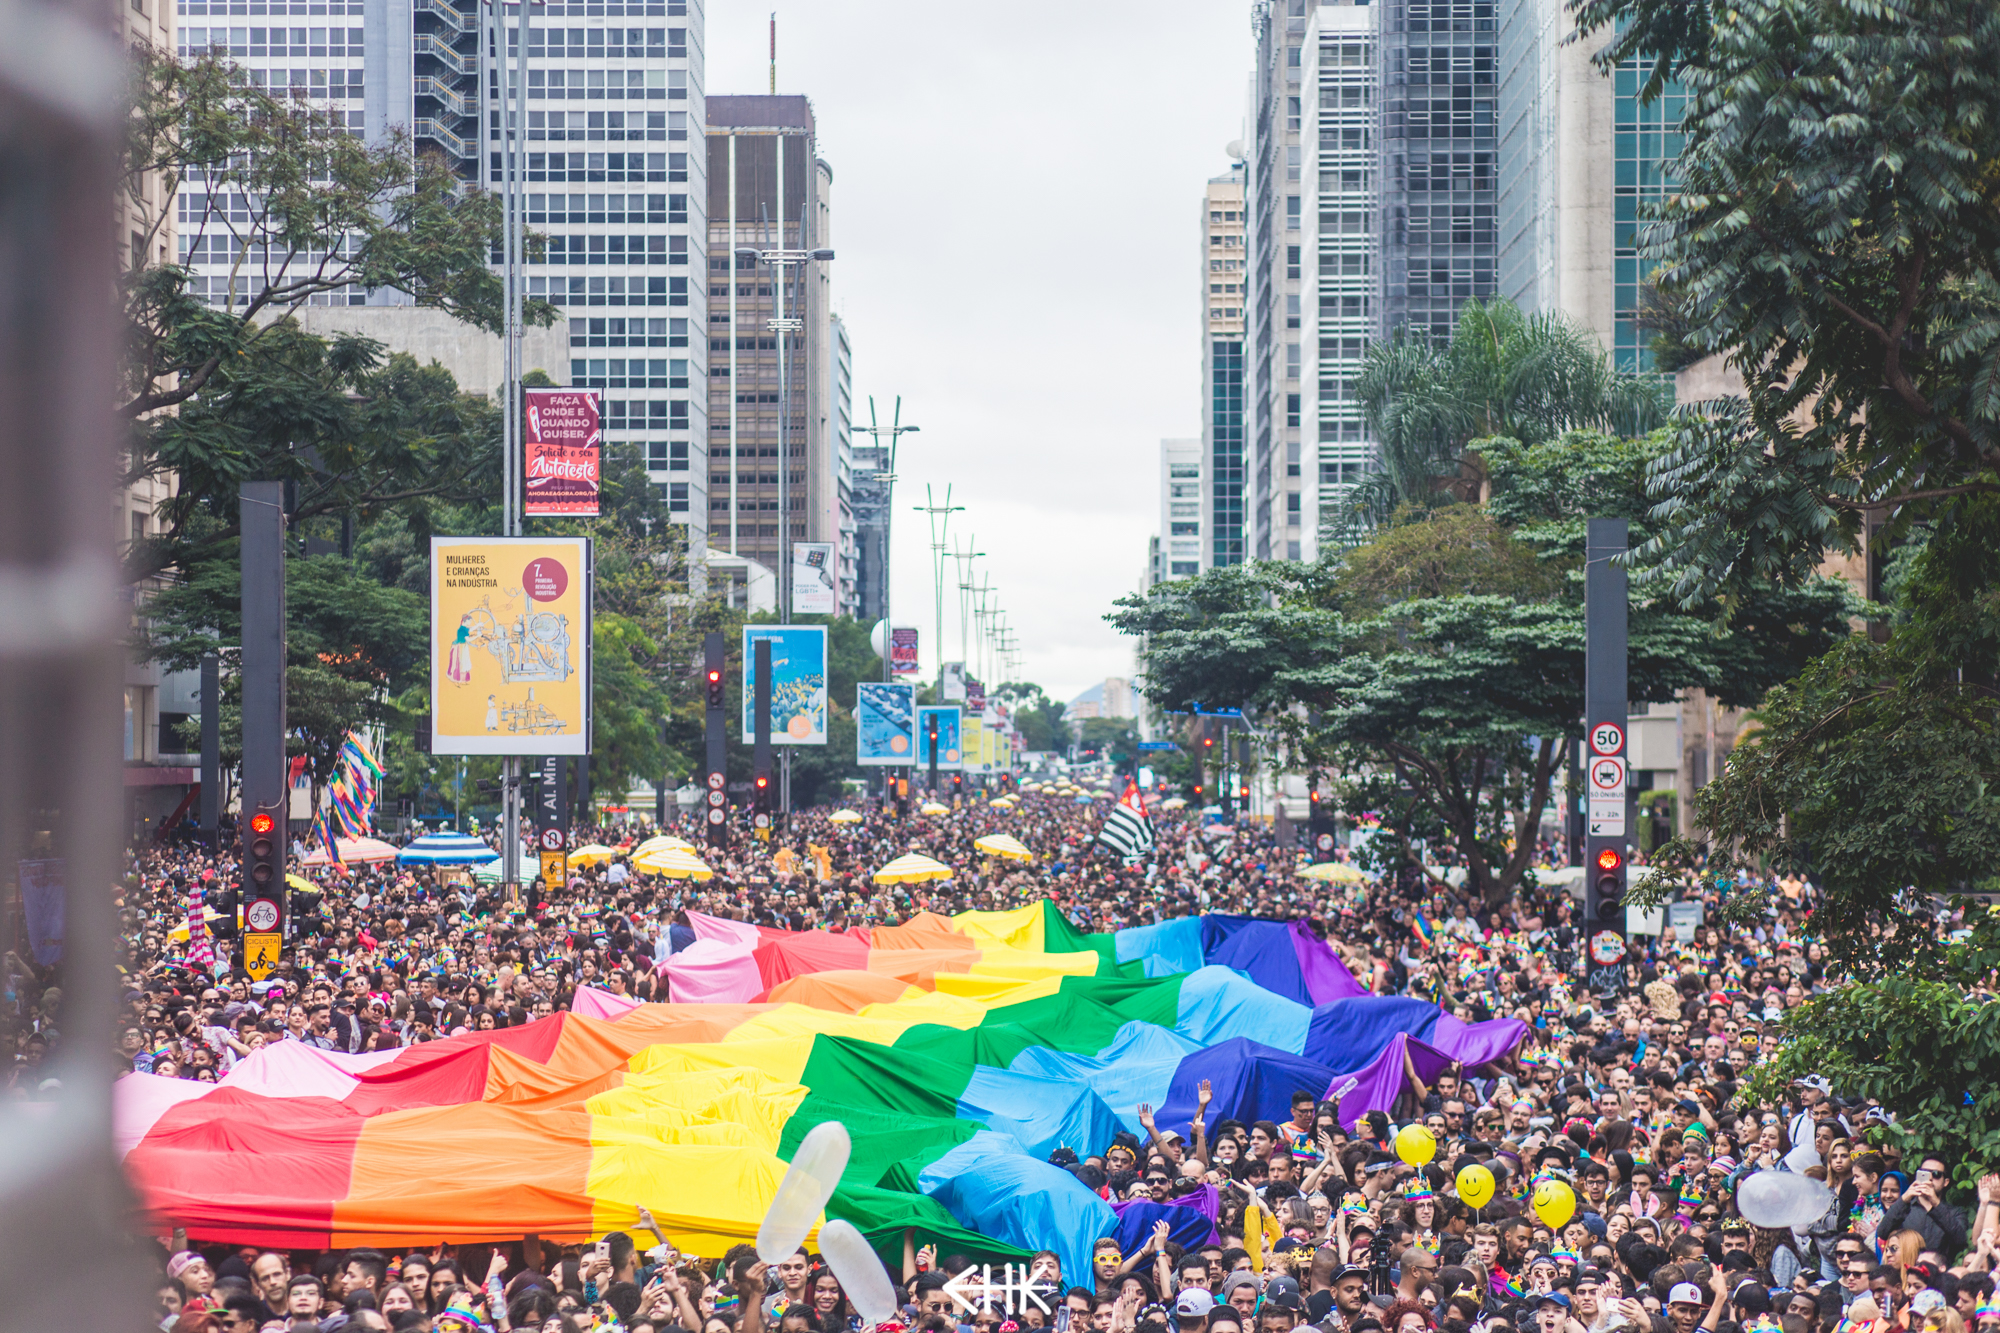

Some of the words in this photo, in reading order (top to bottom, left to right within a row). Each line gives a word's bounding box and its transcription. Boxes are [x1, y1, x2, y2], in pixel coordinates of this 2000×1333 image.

[550, 397, 580, 406] FAÇA
[542, 408, 575, 416] ONDE
[577, 408, 585, 416] E
[540, 419, 590, 427] QUANDO
[542, 430, 587, 438] QUISER.
[534, 446, 567, 457] Solicite
[530, 456, 596, 479] Autoteste
[446, 555, 485, 564] MULHERES
[446, 567, 450, 576] E
[452, 567, 490, 577] CRIANÇAS
[534, 564, 542, 577] 7.
[446, 579, 457, 587] NA
[458, 577, 498, 587] INDÚSTRIA
[1597, 731, 1619, 745] 50
[544, 790, 557, 810] Al.
[711, 793, 722, 801] 50
